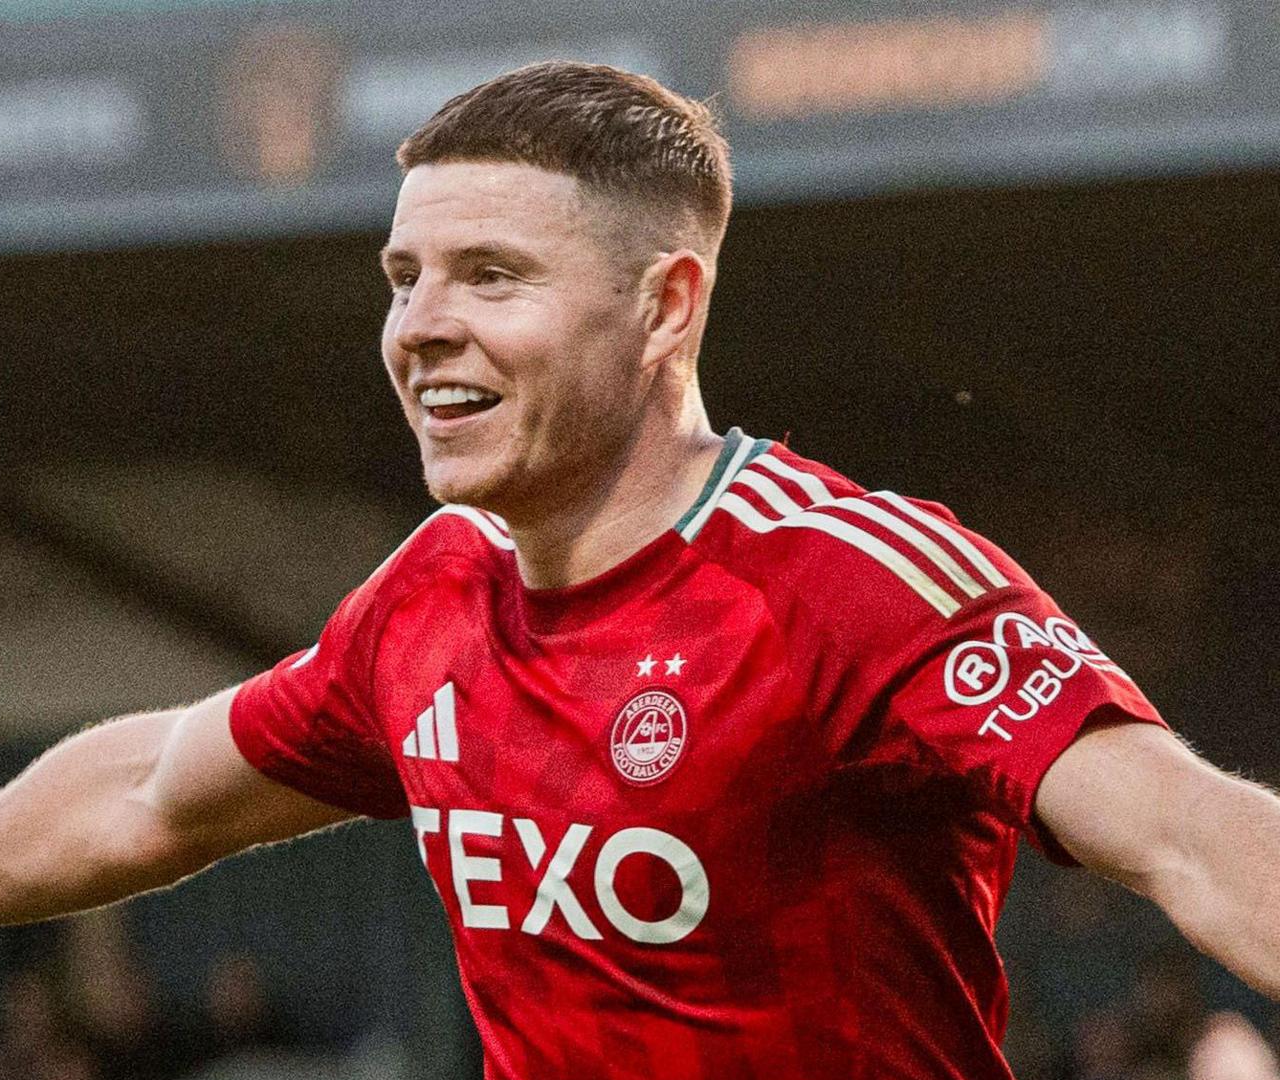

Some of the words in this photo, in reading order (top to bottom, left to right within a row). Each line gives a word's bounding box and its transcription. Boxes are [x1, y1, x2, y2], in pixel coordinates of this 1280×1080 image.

[625, 695, 678, 720] ABERDEEN
[978, 648, 1094, 742] TUBU
[613, 742, 660, 777] FOOTBALL
[658, 737, 682, 768] CLUB
